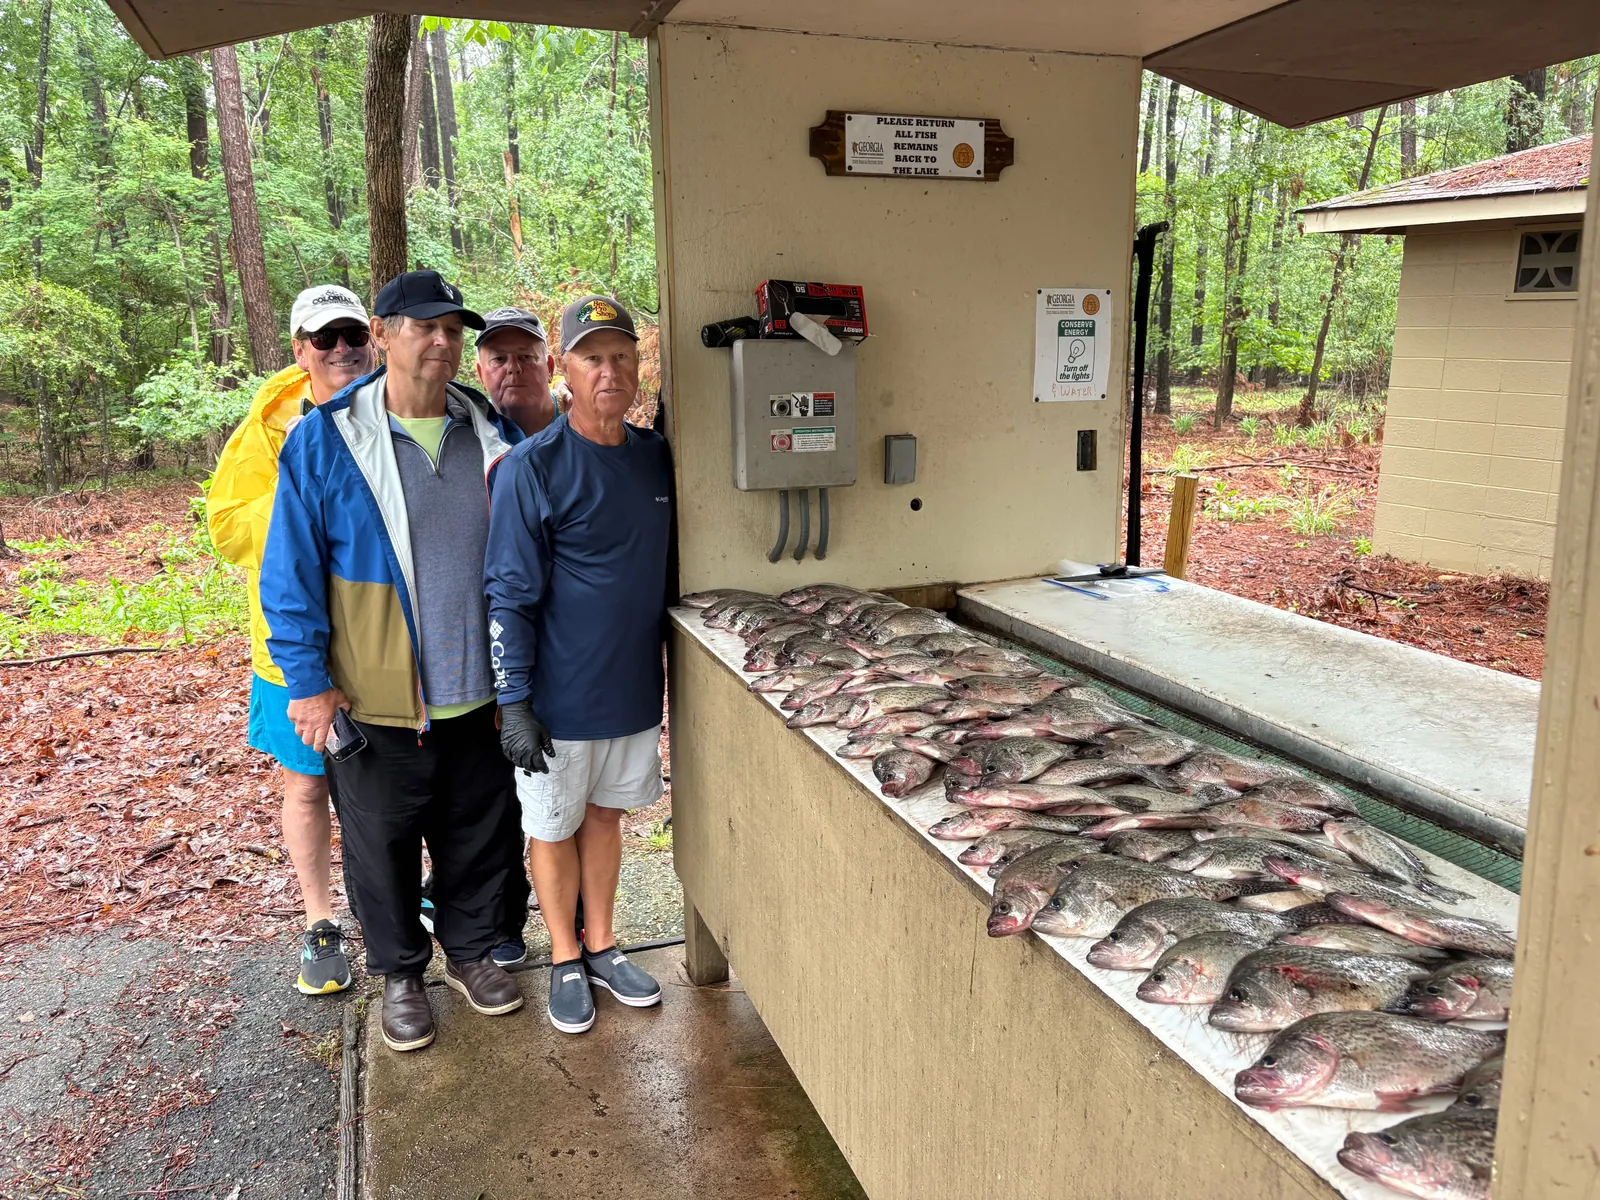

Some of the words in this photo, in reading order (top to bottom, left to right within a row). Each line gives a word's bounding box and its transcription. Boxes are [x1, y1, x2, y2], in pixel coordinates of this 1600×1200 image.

[877, 117, 914, 126] PLEASE
[916, 119, 955, 128] RETURN
[895, 130, 913, 139] ALL
[915, 131, 937, 139] FISH
[858, 142, 884, 152] GEORGIA
[893, 142, 938, 151] REMAINS
[895, 155, 922, 163] BACK
[924, 155, 937, 163] TO
[892, 166, 912, 175] THE
[914, 167, 939, 175] LAKE
[312, 295, 354, 305] COLONIAL
[1052, 294, 1075, 303] GEORGIA
[1063, 364, 1078, 372] Turn
[1079, 364, 1089, 372] off
[1071, 372, 1090, 381] lights
